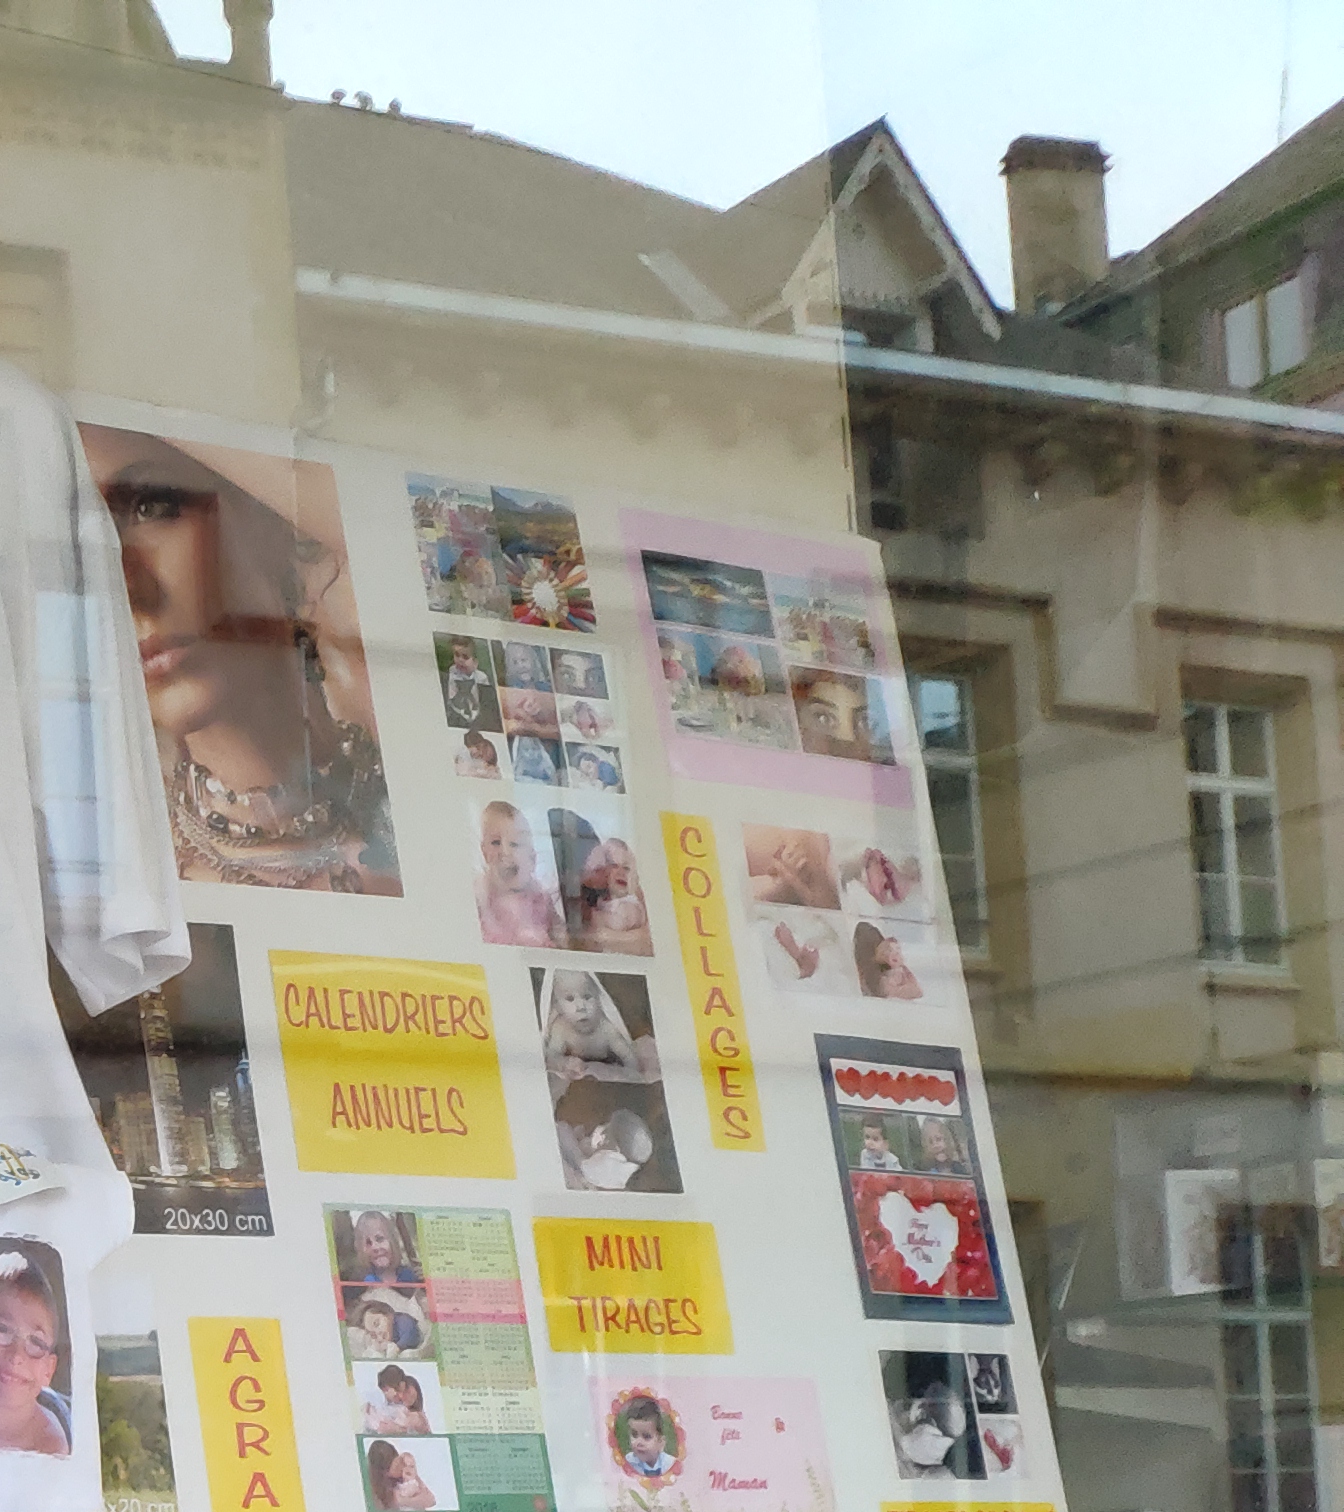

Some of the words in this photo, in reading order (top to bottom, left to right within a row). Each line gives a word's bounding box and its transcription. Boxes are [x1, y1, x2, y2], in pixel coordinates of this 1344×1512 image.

[678, 825, 753, 1142] COLLAGES
[284, 981, 491, 1042] CALENDRIERS
[330, 1081, 468, 1137] ANNUELS
[163, 1207, 229, 1231] 20x30
[235, 1214, 269, 1232] cm
[585, 1234, 664, 1273] MINI
[568, 1294, 703, 1337] TIRAGES
